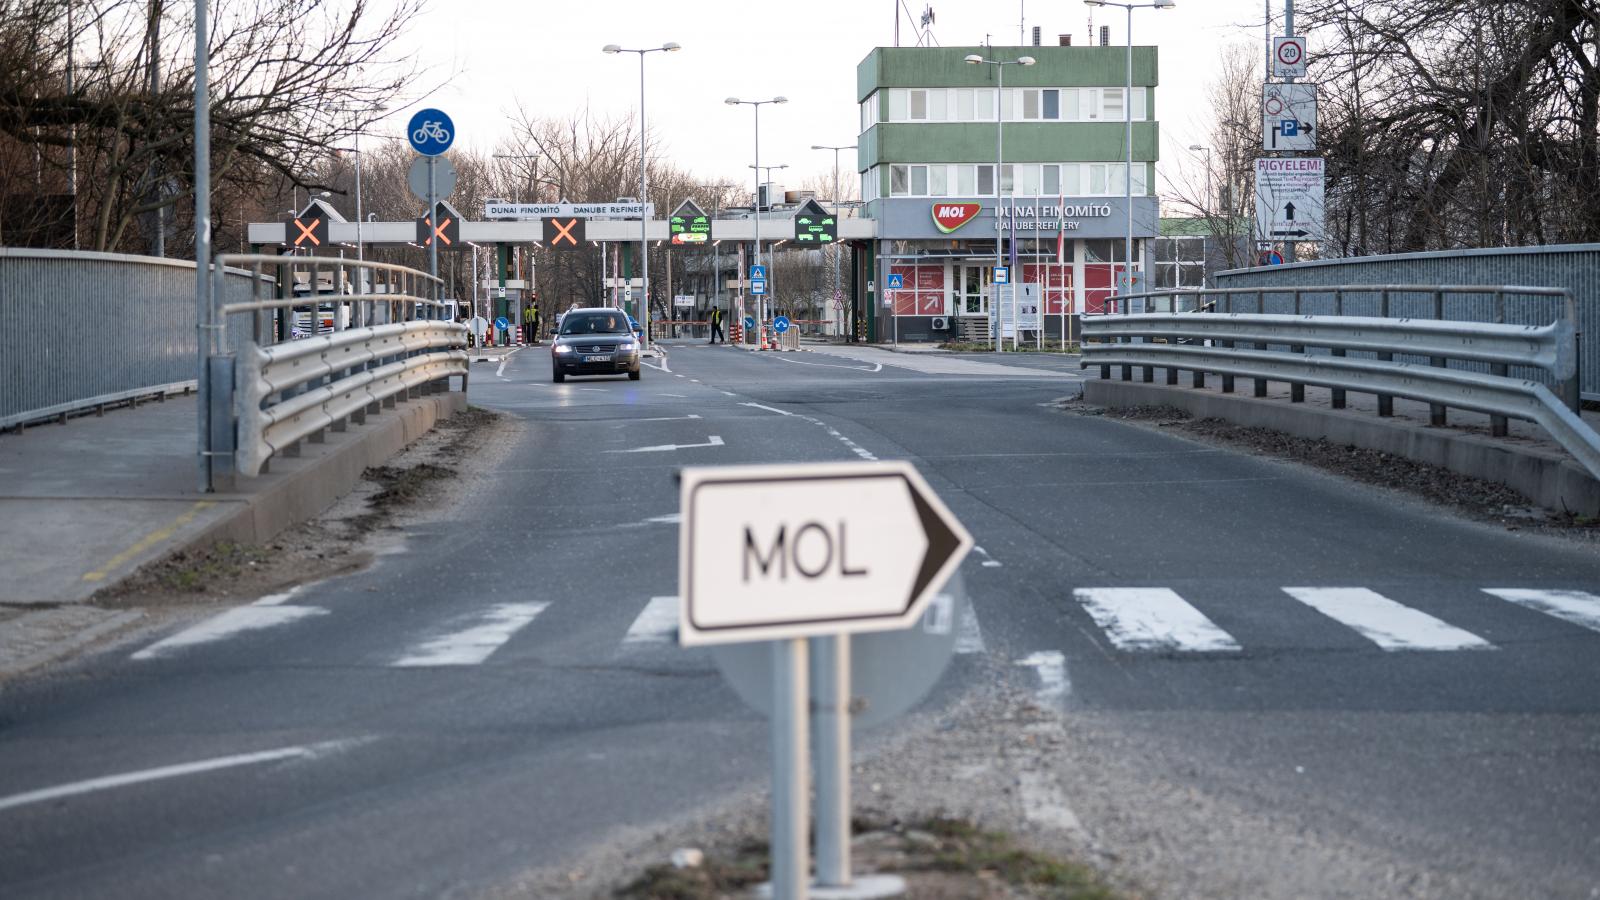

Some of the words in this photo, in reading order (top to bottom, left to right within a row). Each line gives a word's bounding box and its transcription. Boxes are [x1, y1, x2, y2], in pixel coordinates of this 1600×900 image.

[1284, 48, 1296, 58] 20
[1284, 122, 1294, 135] P
[1258, 160, 1322, 171] FIGYELEM!
[520, 204, 560, 214] FINOMÍTÓ
[573, 206, 606, 214] DANUBE
[938, 206, 965, 218] MOL
[742, 521, 868, 583] MOL
